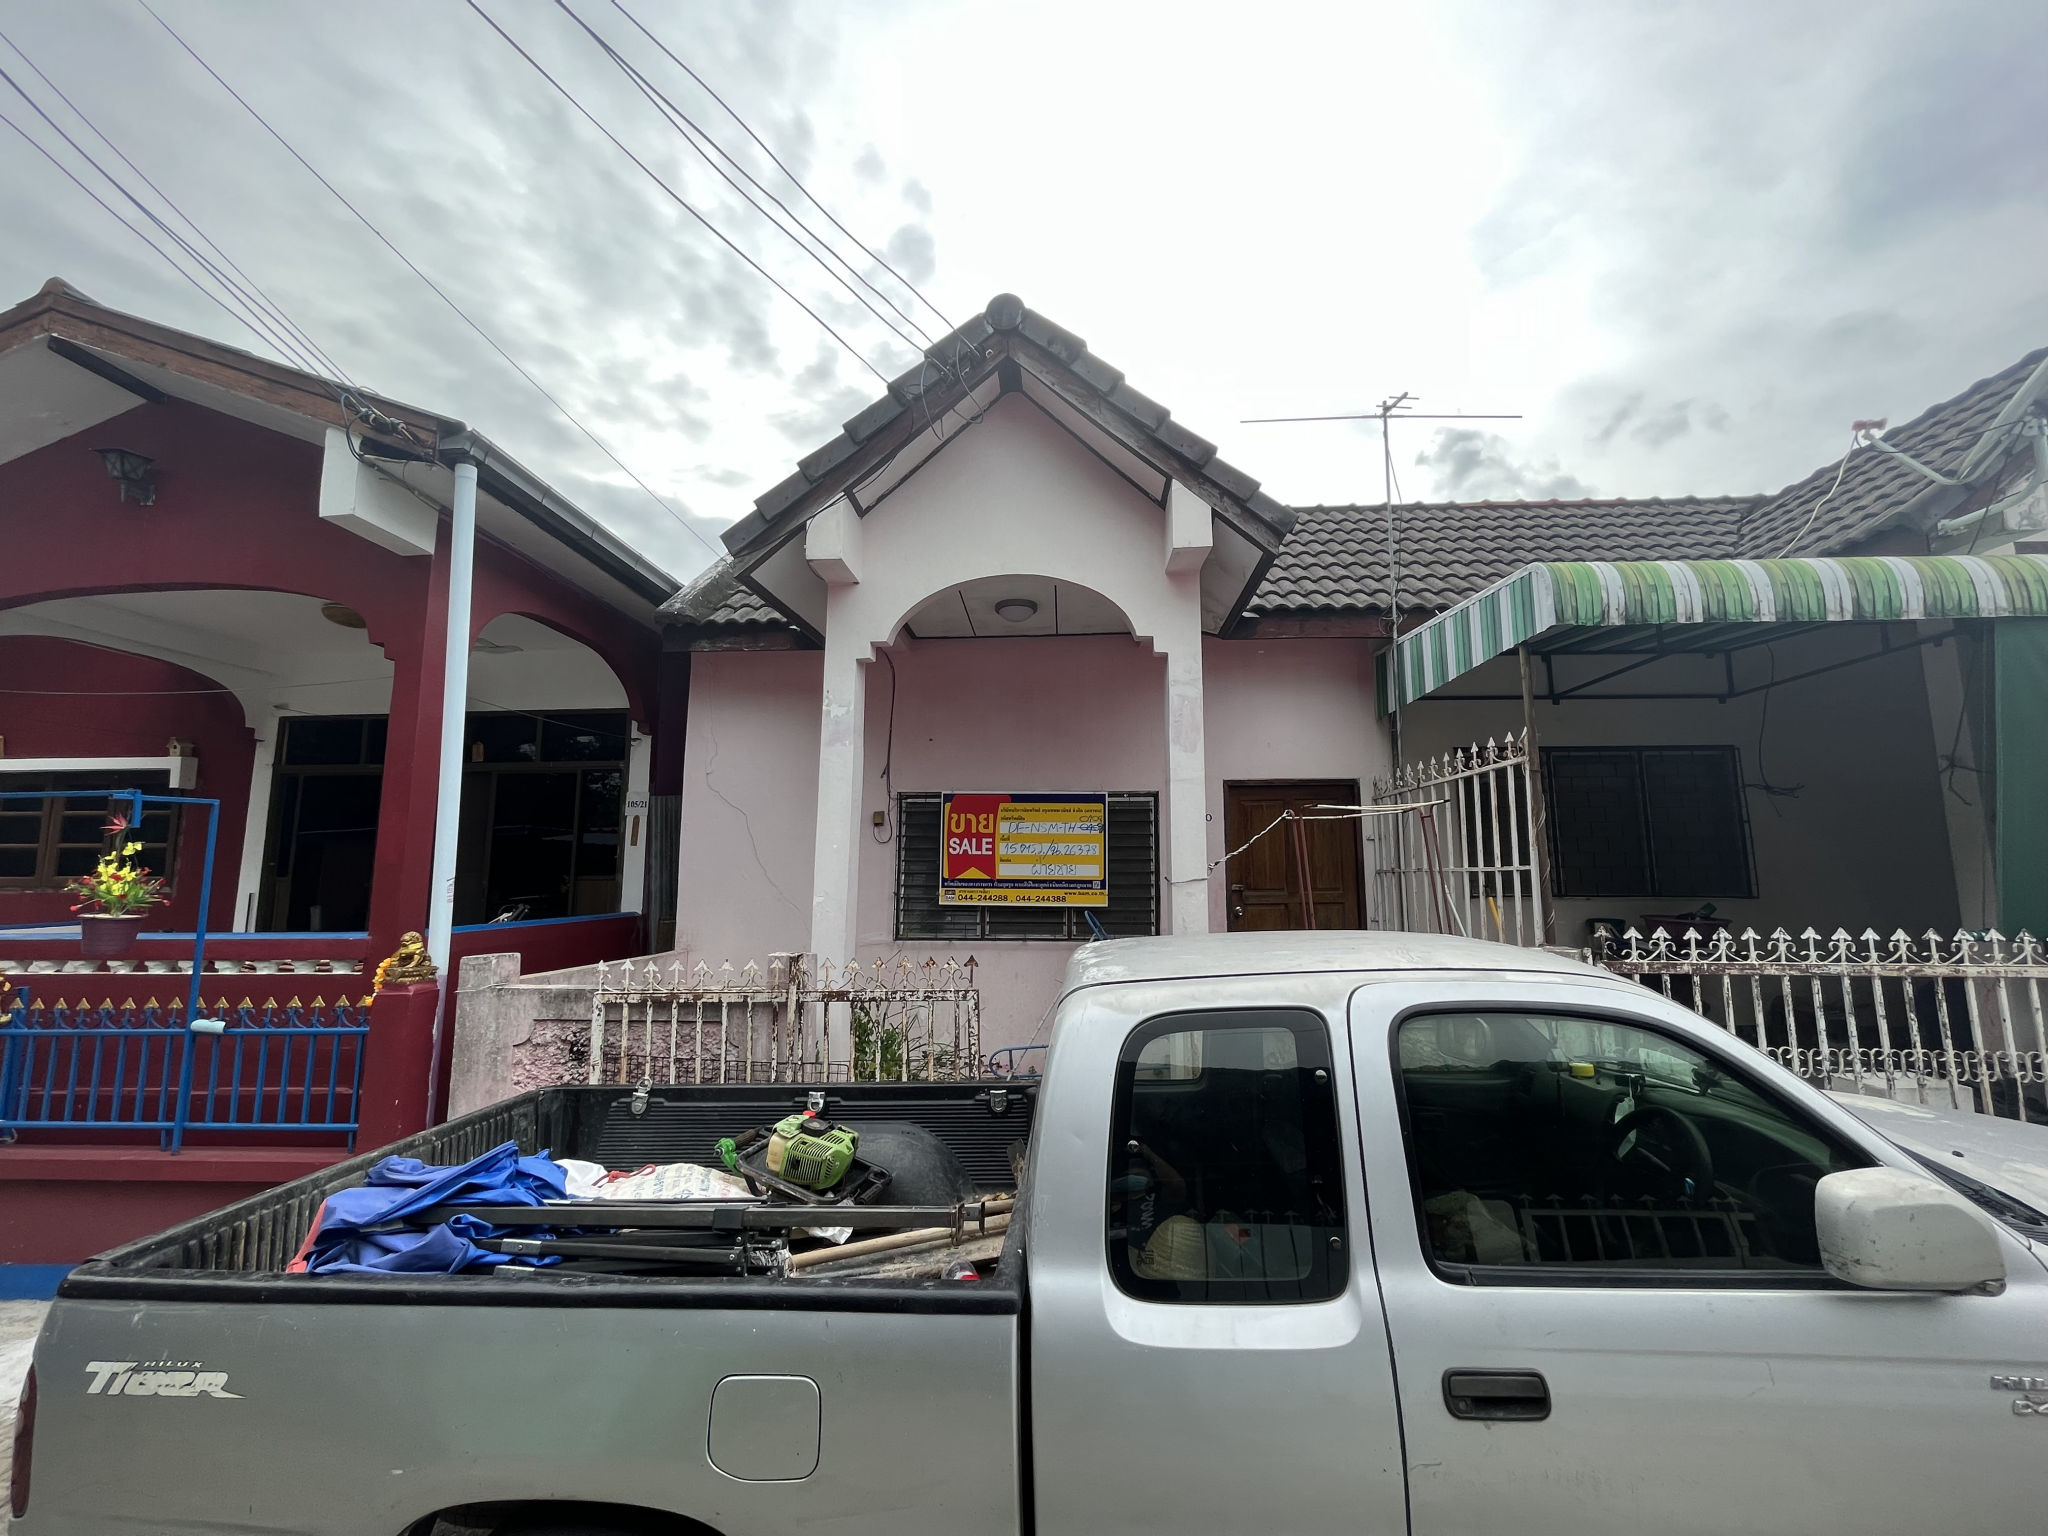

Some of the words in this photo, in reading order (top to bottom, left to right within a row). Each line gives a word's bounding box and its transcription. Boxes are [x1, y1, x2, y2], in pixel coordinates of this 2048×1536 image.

[627, 800, 647, 808] 105/21
[950, 813, 994, 834] ขาย
[949, 837, 993, 855] SALE
[957, 894, 1009, 902] 044-244288
[1015, 895, 1067, 903] 044-244388
[144, 1360, 203, 1369] HILUX
